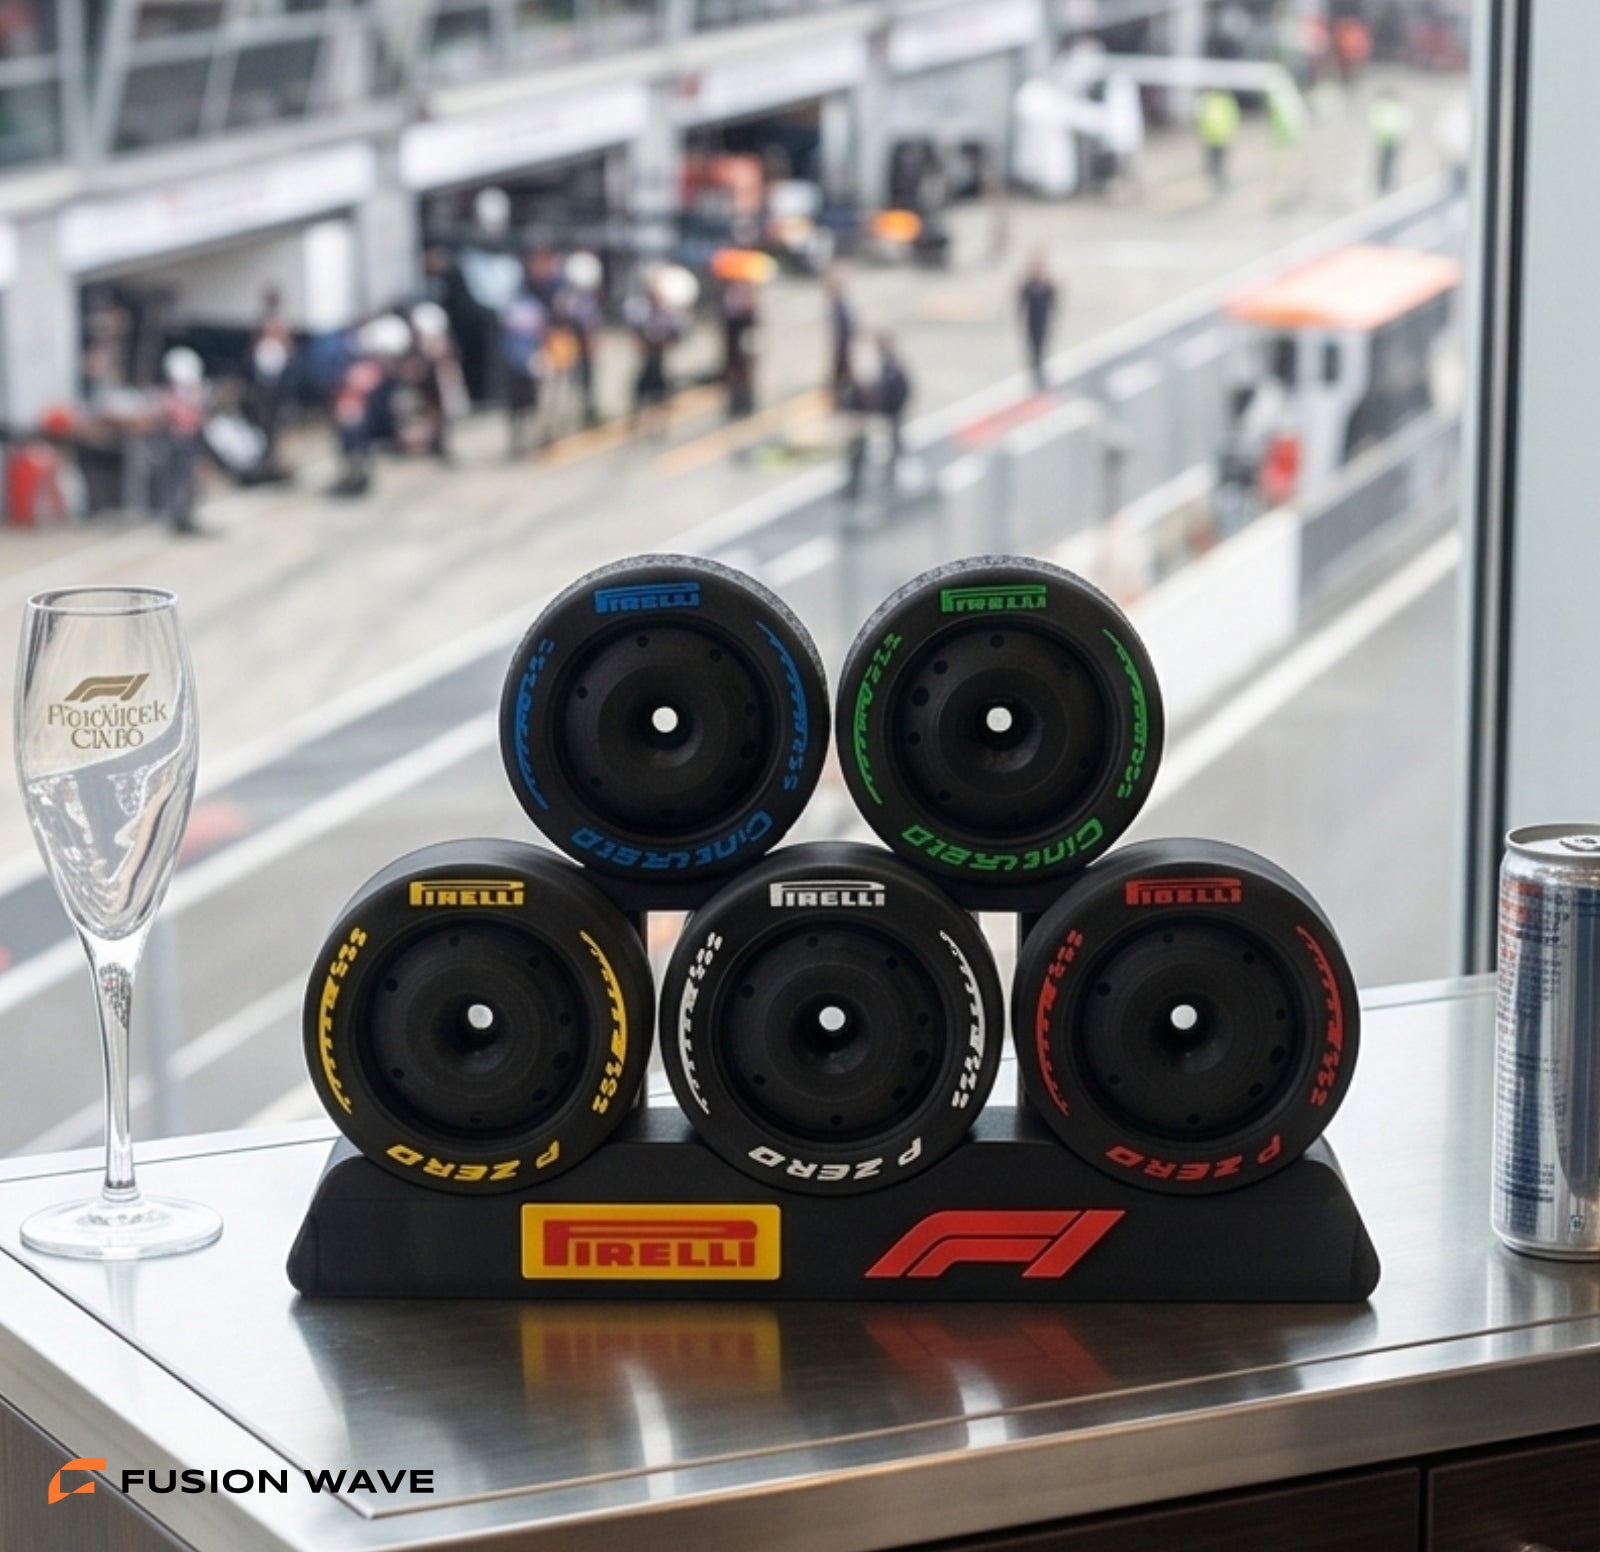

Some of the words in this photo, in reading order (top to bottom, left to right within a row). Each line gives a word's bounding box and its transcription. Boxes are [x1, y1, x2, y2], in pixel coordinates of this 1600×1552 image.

[409, 879, 525, 906] PIRELLI
[769, 880, 885, 907] PIRELLI
[386, 1143, 520, 1182] ZERO
[535, 1140, 560, 1169] P
[748, 1145, 884, 1181] ZERO
[897, 1137, 922, 1167] P
[1105, 1145, 1243, 1181] ZERO
[1256, 1134, 1282, 1164] P
[543, 1220, 758, 1267] PIRELLI
